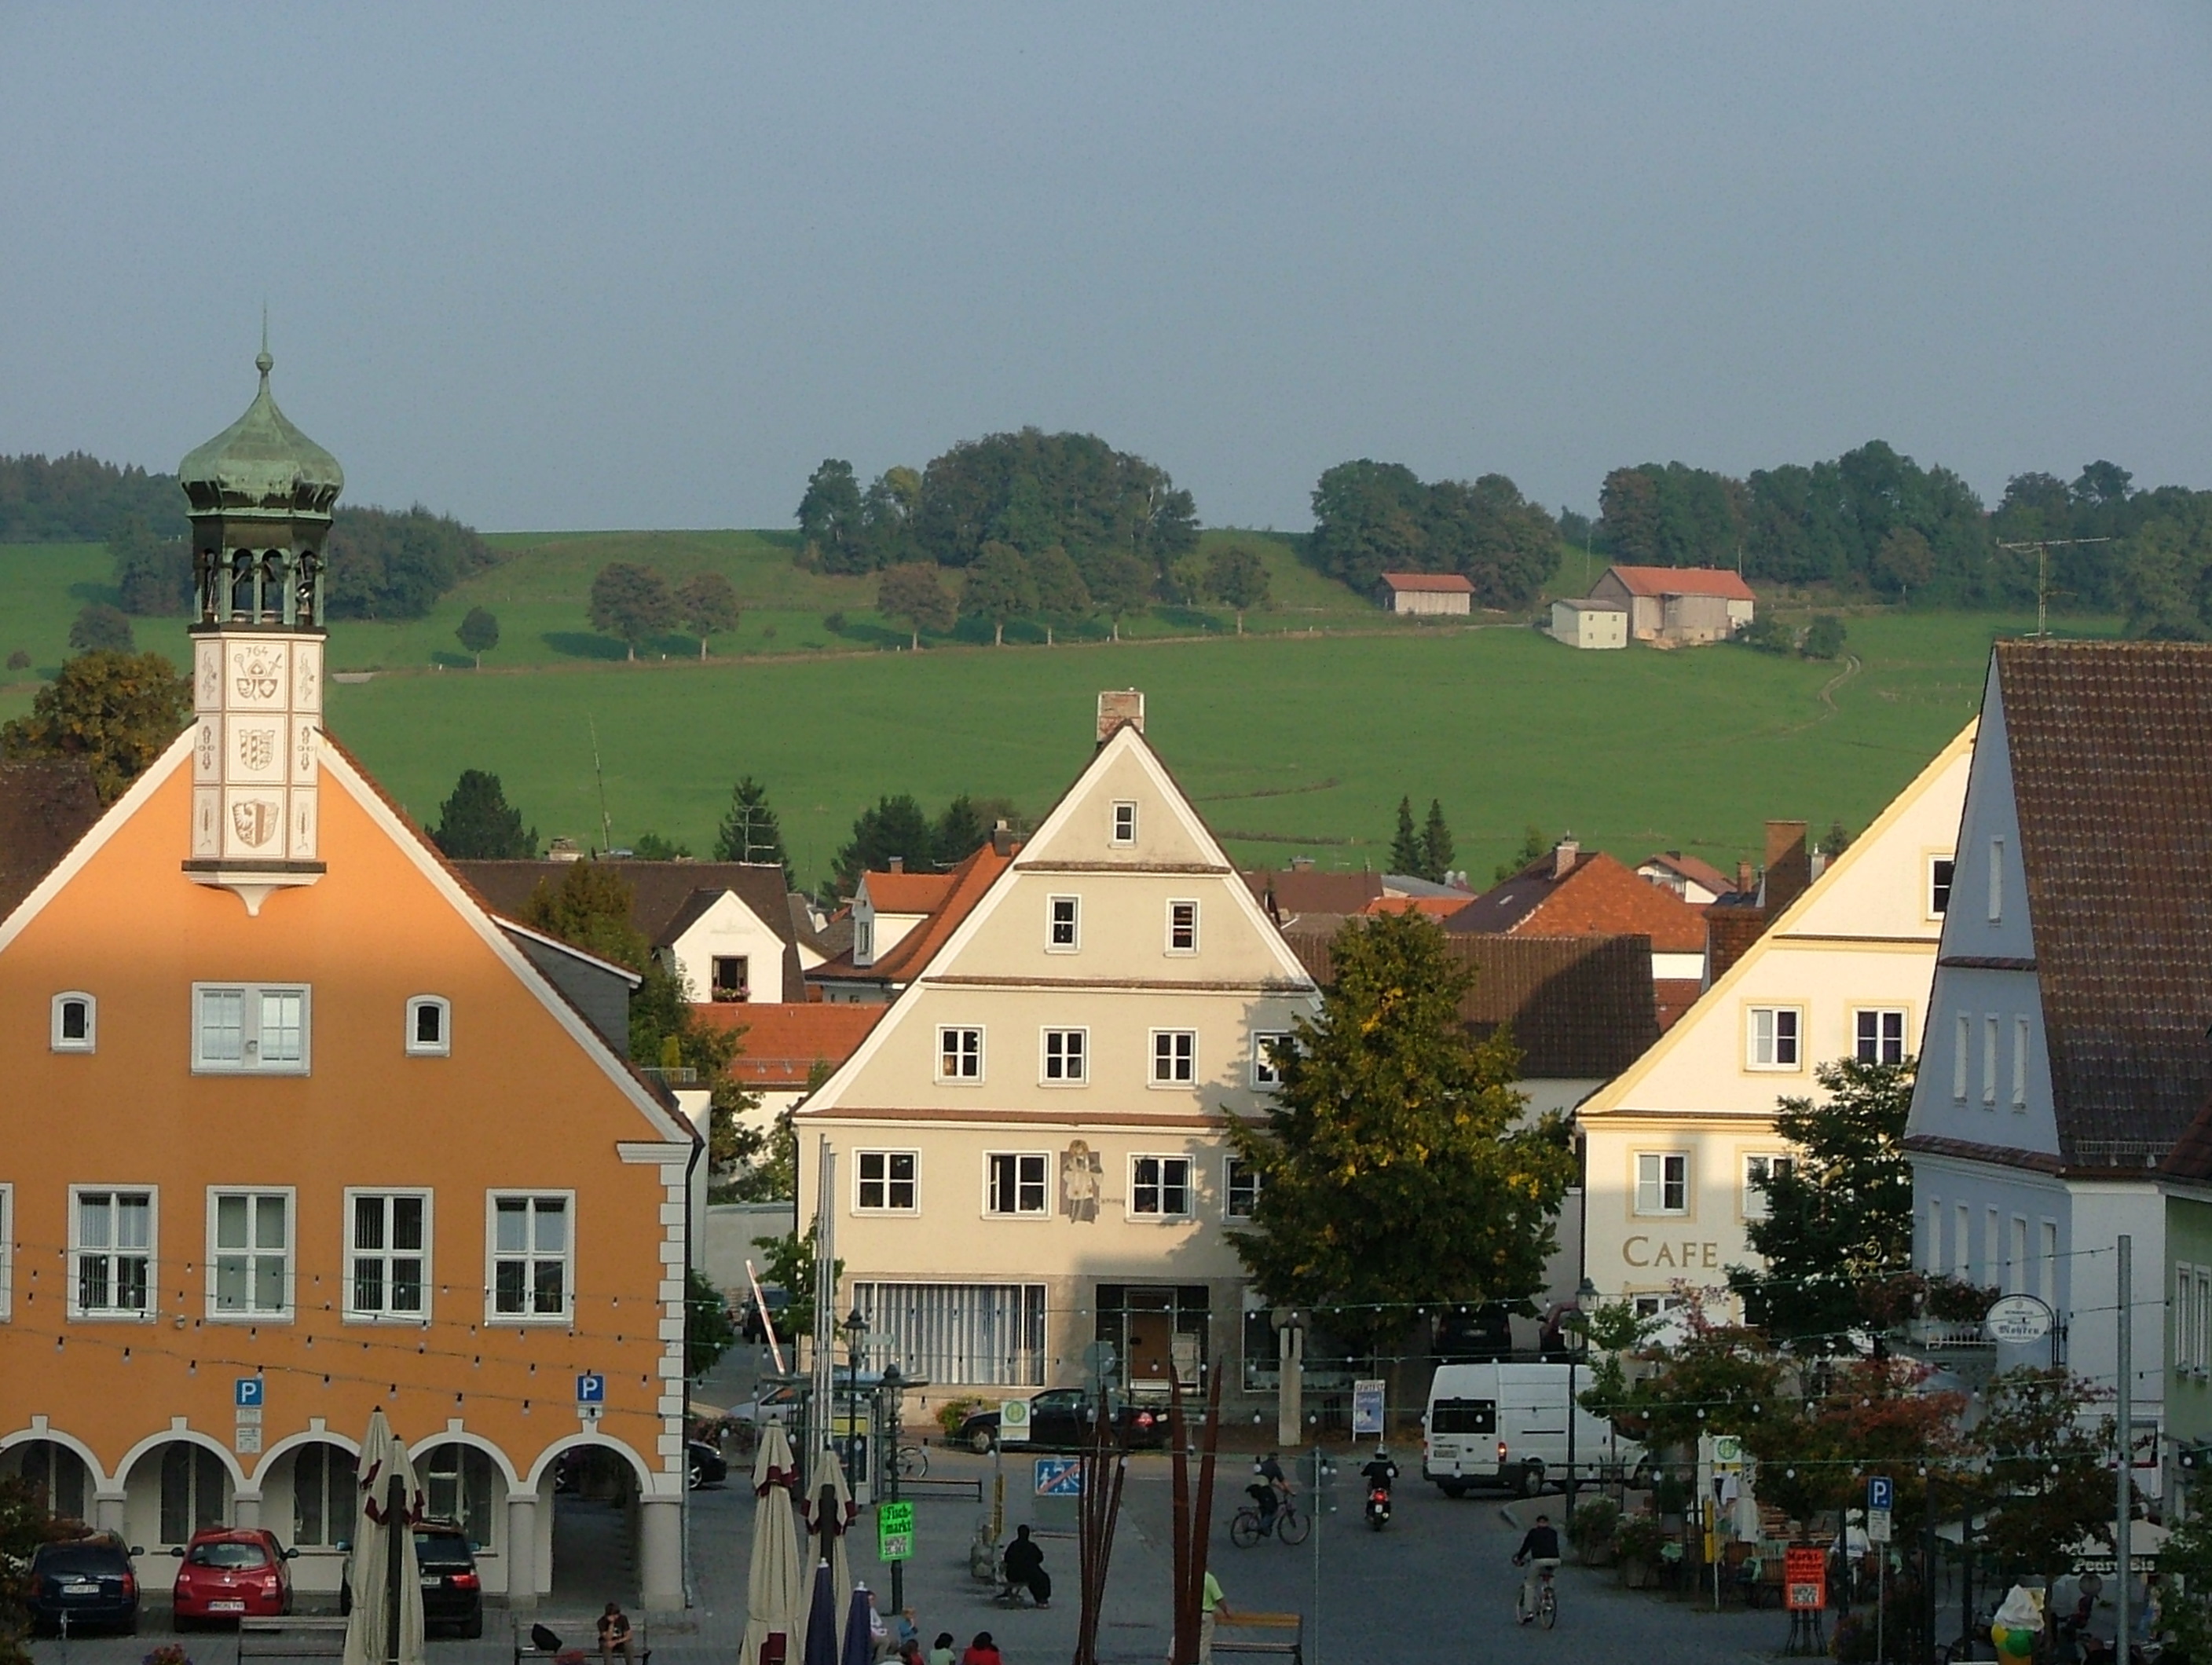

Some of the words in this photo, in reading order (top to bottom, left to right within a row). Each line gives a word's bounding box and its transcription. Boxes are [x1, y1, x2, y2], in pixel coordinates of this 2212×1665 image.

[1622, 1235, 1718, 1268] CAFE
[241, 1381, 257, 1403] P
[582, 1378, 598, 1399] P
[1873, 1480, 1887, 1504] P
